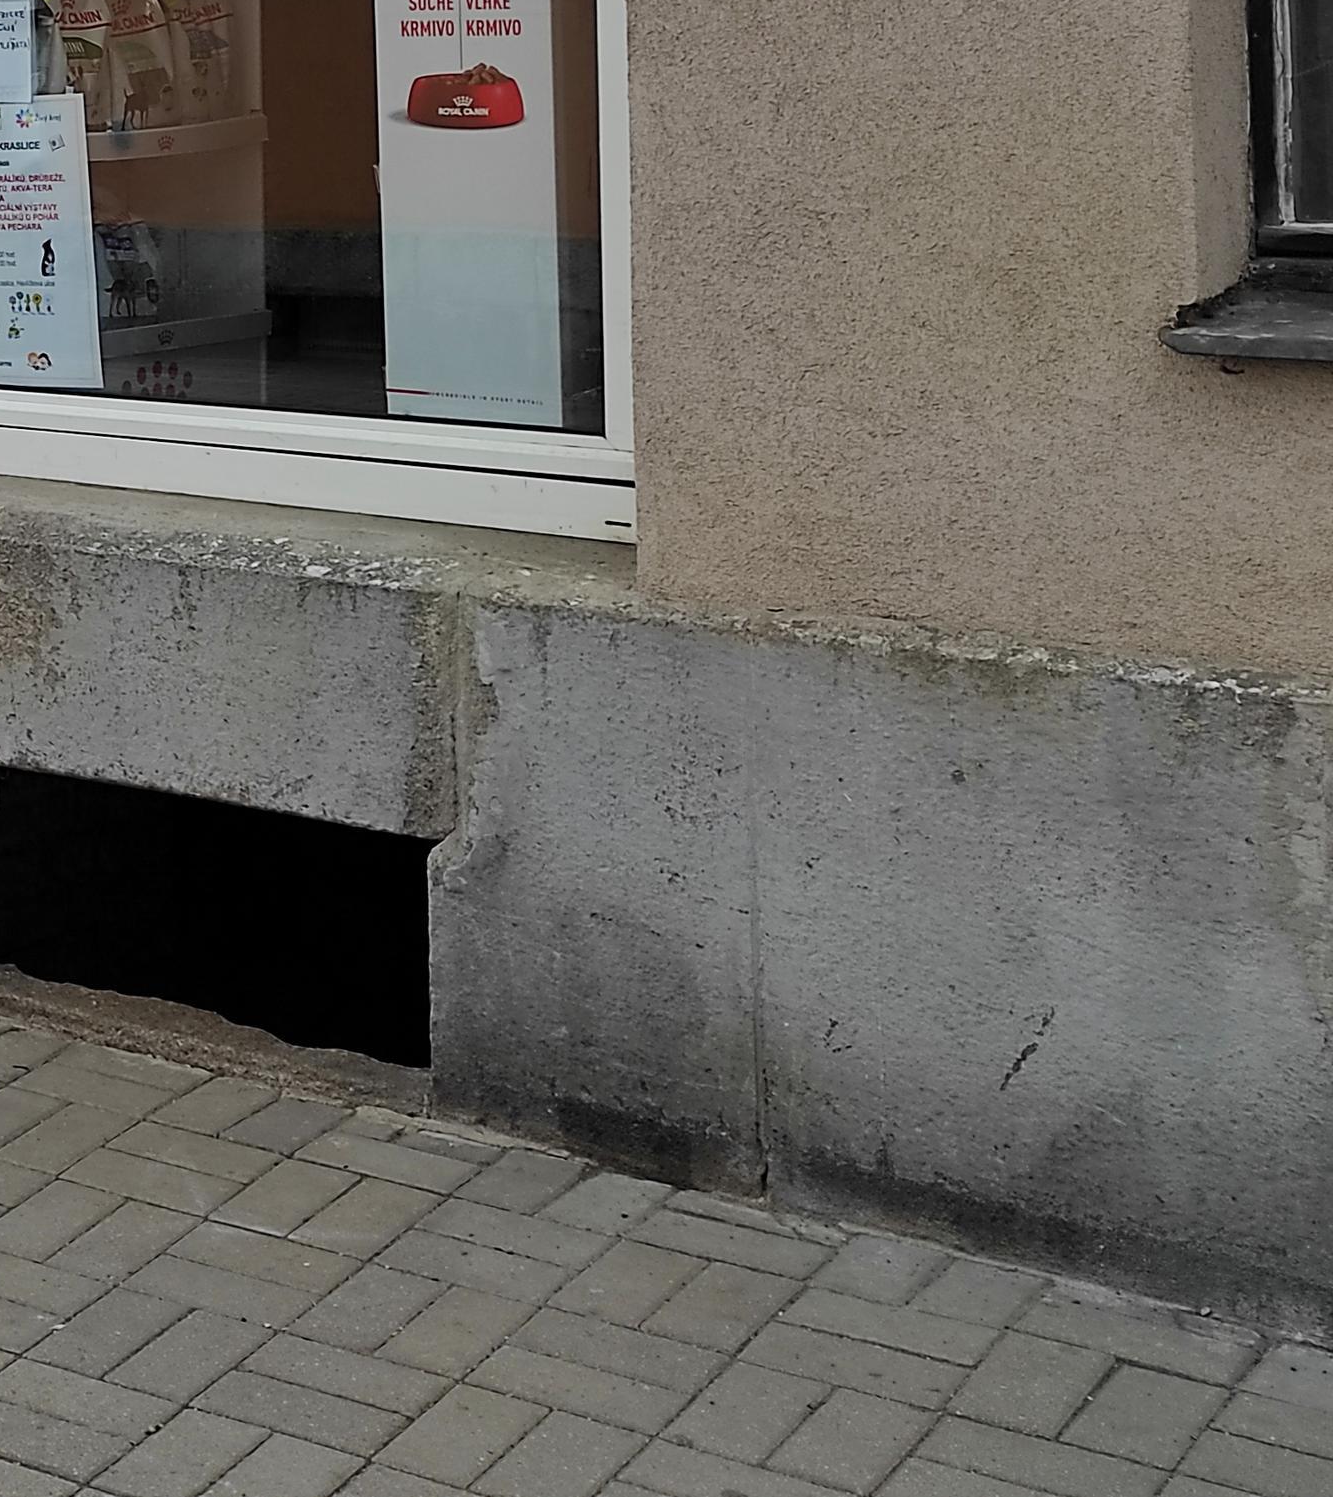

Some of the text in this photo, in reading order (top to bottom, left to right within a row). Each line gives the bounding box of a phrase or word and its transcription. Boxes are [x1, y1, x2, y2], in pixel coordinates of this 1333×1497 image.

[68, 9, 102, 24] CANIN
[400, 19, 522, 37] KRMIVO KRMIVO
[11, 183, 53, 192] AKVA-TERA
[24, 203, 57, 212] VÝSTAVY
[32, 211, 59, 221] POHÁR
[8, 222, 42, 231] PECHARA
